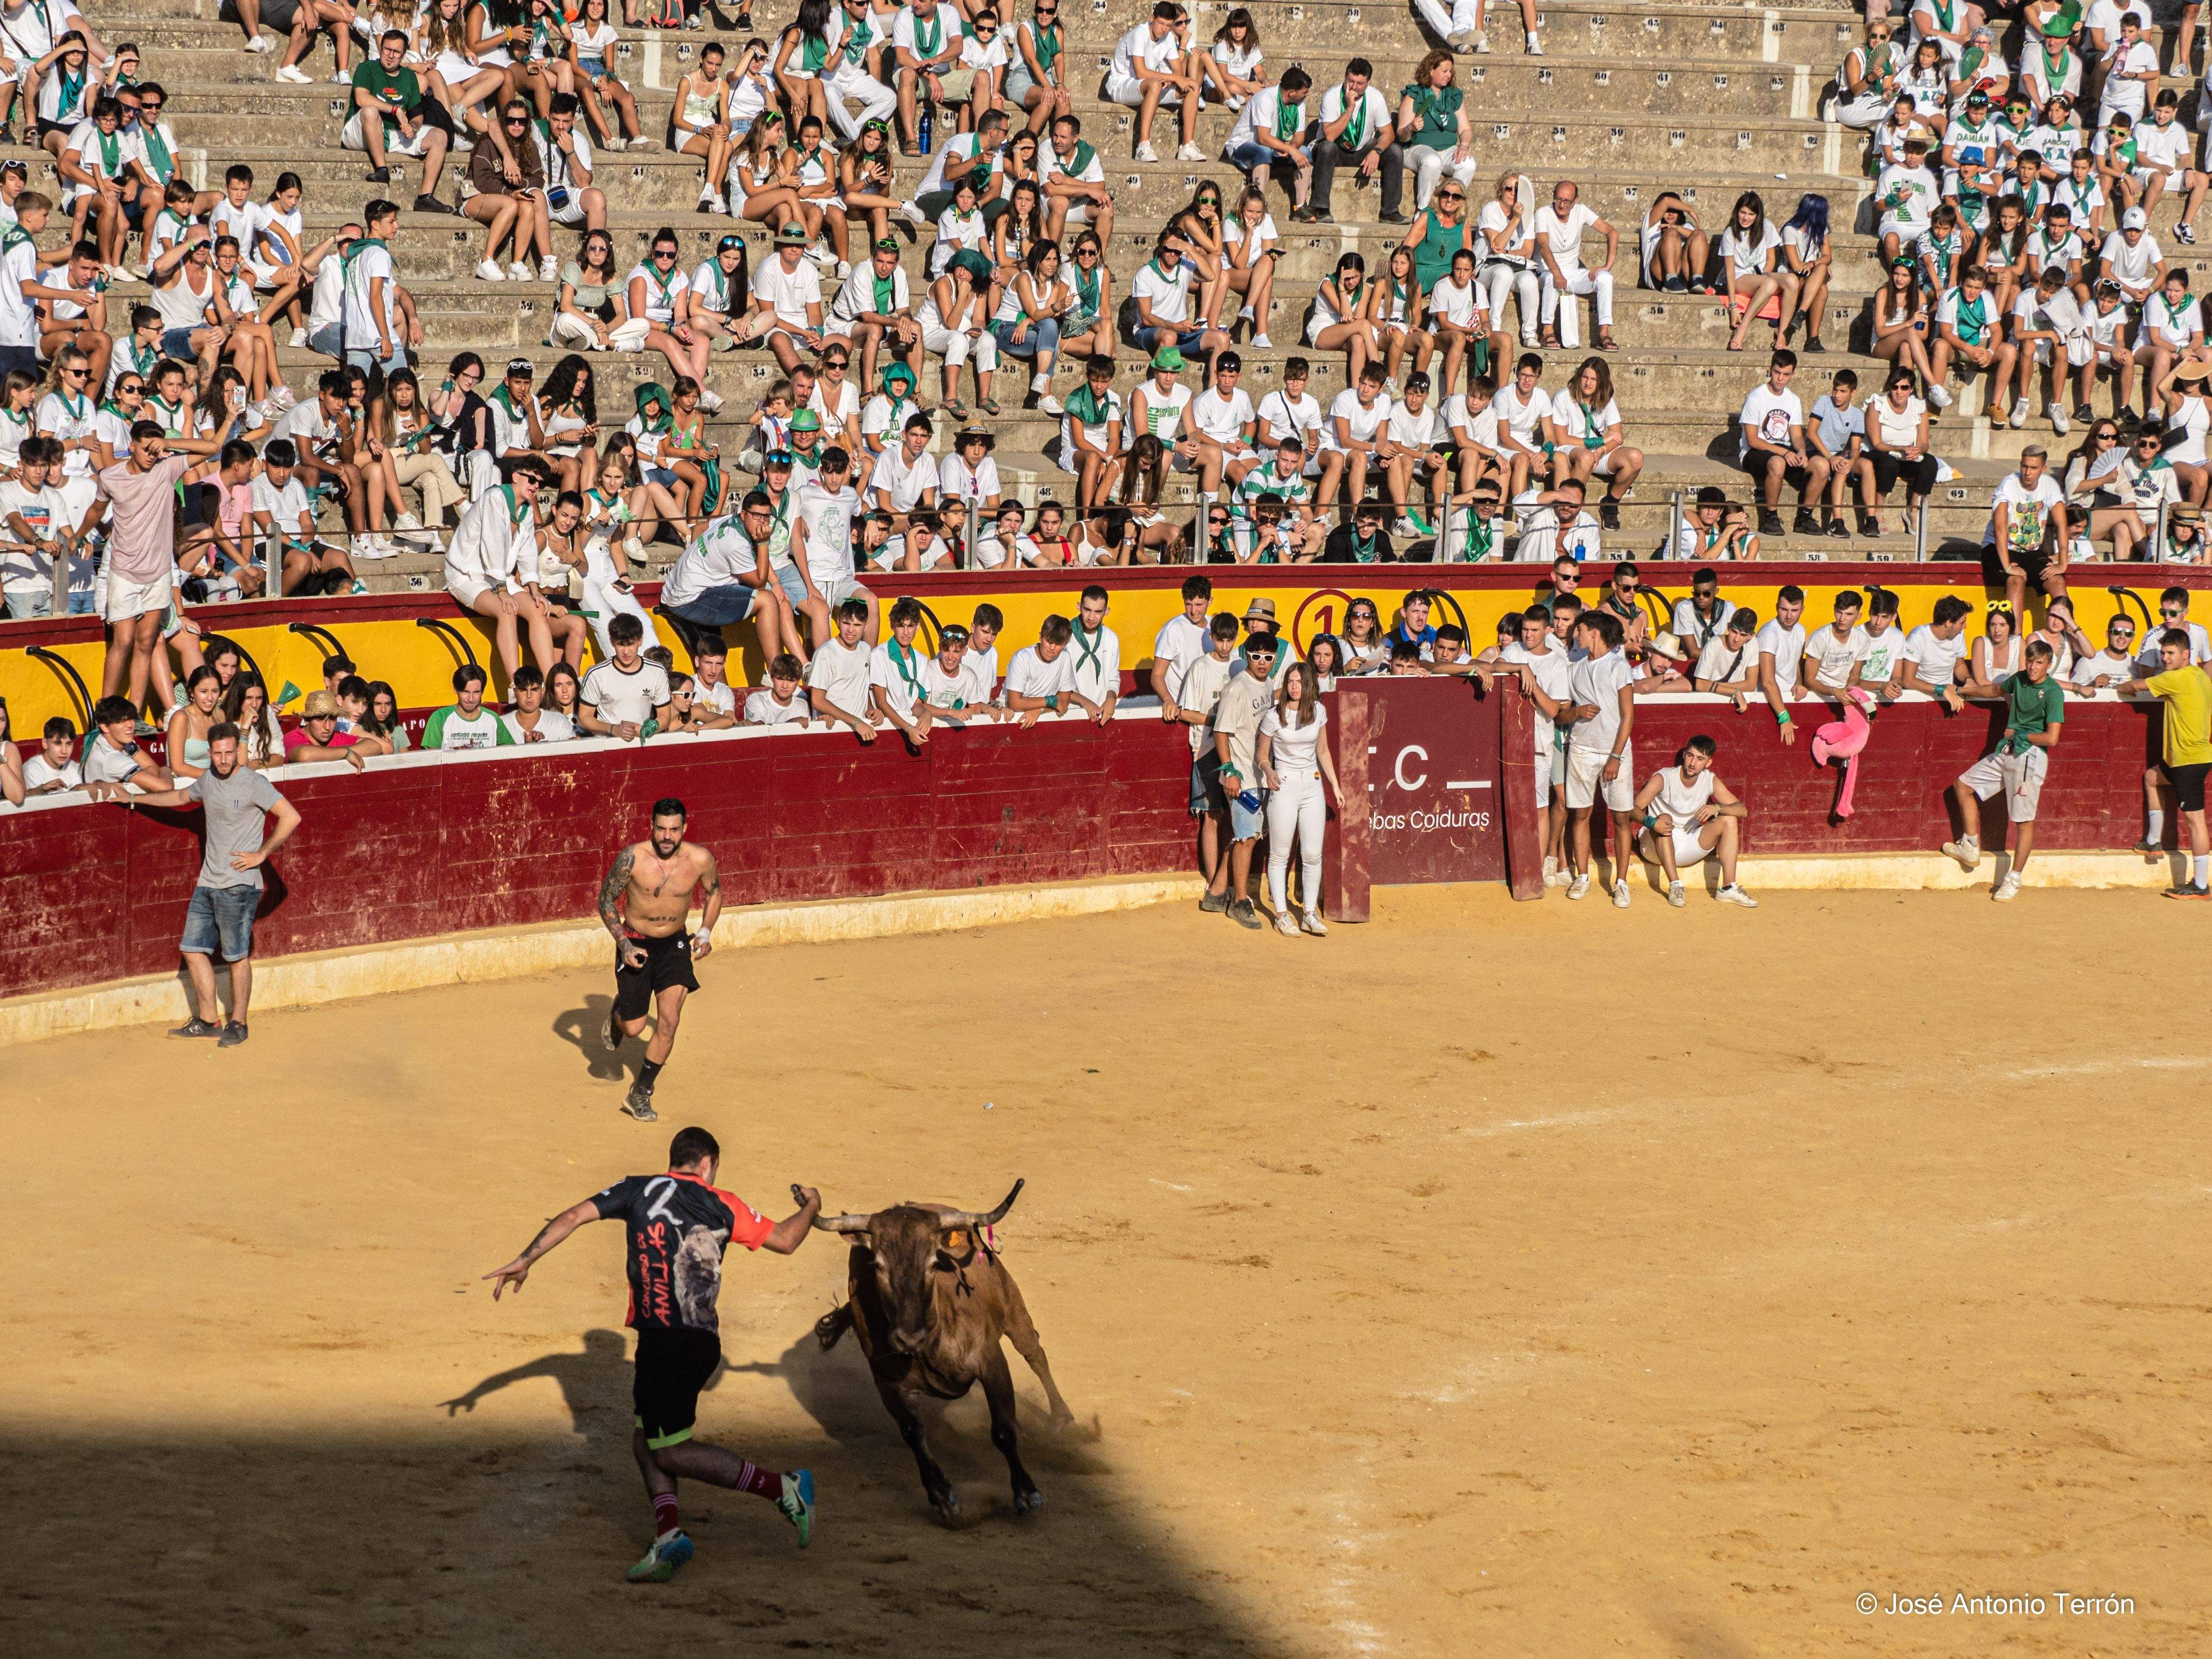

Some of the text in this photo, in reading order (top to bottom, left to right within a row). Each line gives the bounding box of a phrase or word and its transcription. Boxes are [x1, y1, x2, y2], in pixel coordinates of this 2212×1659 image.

[1950, 490, 1964, 498] 62
[1314, 605, 1333, 634] 1
[1394, 745, 1428, 791] C
[1410, 809, 1490, 829] Coiduras
[639, 1253, 651, 1319] CONCURSO
[647, 1221, 671, 1327] ANILLAS
